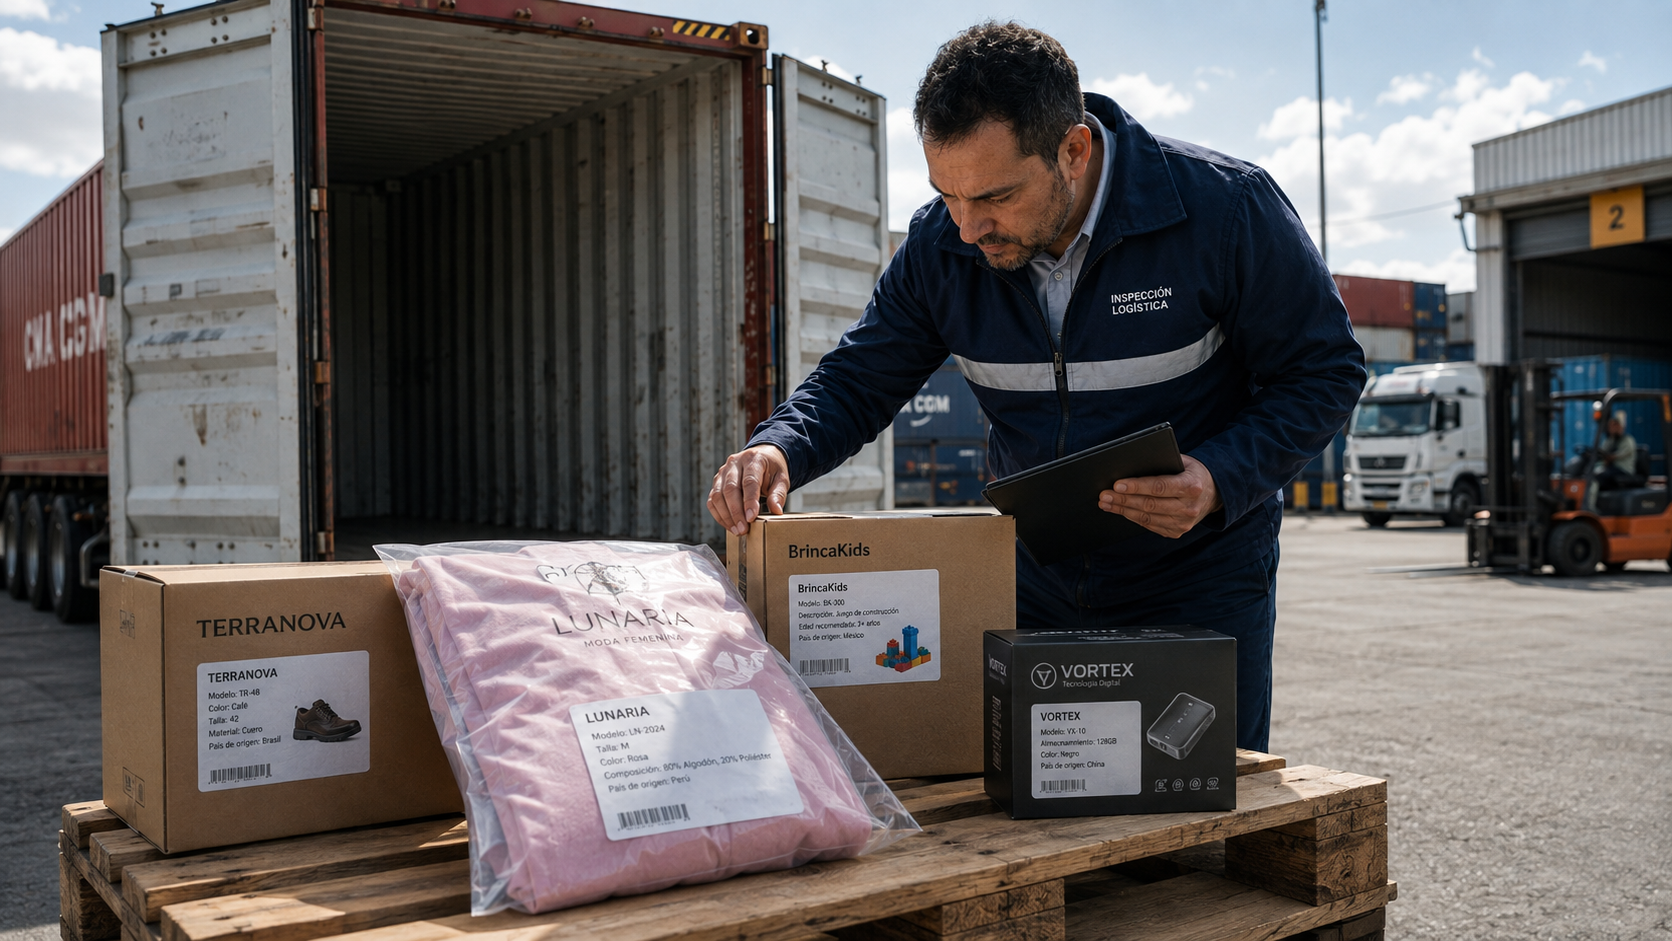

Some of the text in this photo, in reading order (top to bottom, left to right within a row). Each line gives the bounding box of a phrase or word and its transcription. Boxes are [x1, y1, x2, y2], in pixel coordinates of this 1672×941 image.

[1609, 204, 1625, 231] 2
[1111, 286, 1172, 303] INSPECCIÓN
[1112, 300, 1169, 315] LOGÍSTICA
[25, 311, 56, 371] CMA
[788, 542, 870, 559] BrincaKids
[797, 582, 848, 594] BrincaKids
[862, 606, 899, 616] construcción
[196, 612, 346, 638] TERRANOVA
[552, 609, 694, 635] LUNARIA
[584, 633, 684, 648] MODA FEMENINA
[208, 668, 278, 683] TERRANOVA
[1061, 663, 1134, 678] VORTEX
[208, 688, 260, 700] Modelo: TR-48
[208, 704, 230, 712] Color:
[585, 706, 650, 723] LUNARIA
[208, 716, 228, 725] Talla:
[1040, 711, 1081, 721] VORTEX
[208, 726, 263, 737] Material: Cuero
[591, 724, 665, 740] Modelo: LN-2024
[1040, 727, 1086, 736] Modelo: VX-10
[236, 739, 260, 748] origen:
[262, 735, 281, 744] Brasil
[595, 742, 630, 753] Talla: M
[1097, 737, 1118, 745] 128GB
[600, 754, 649, 767] Color: Rosa
[1060, 750, 1080, 759] Negro
[604, 765, 662, 780] Composición:
[663, 762, 682, 772] 80%
[683, 758, 720, 770] Algodón,
[720, 755, 738, 764] 20%
[1086, 760, 1105, 768] China
[628, 782, 639, 790] de
[641, 778, 670, 789] origen:
[670, 774, 691, 784] Perú
